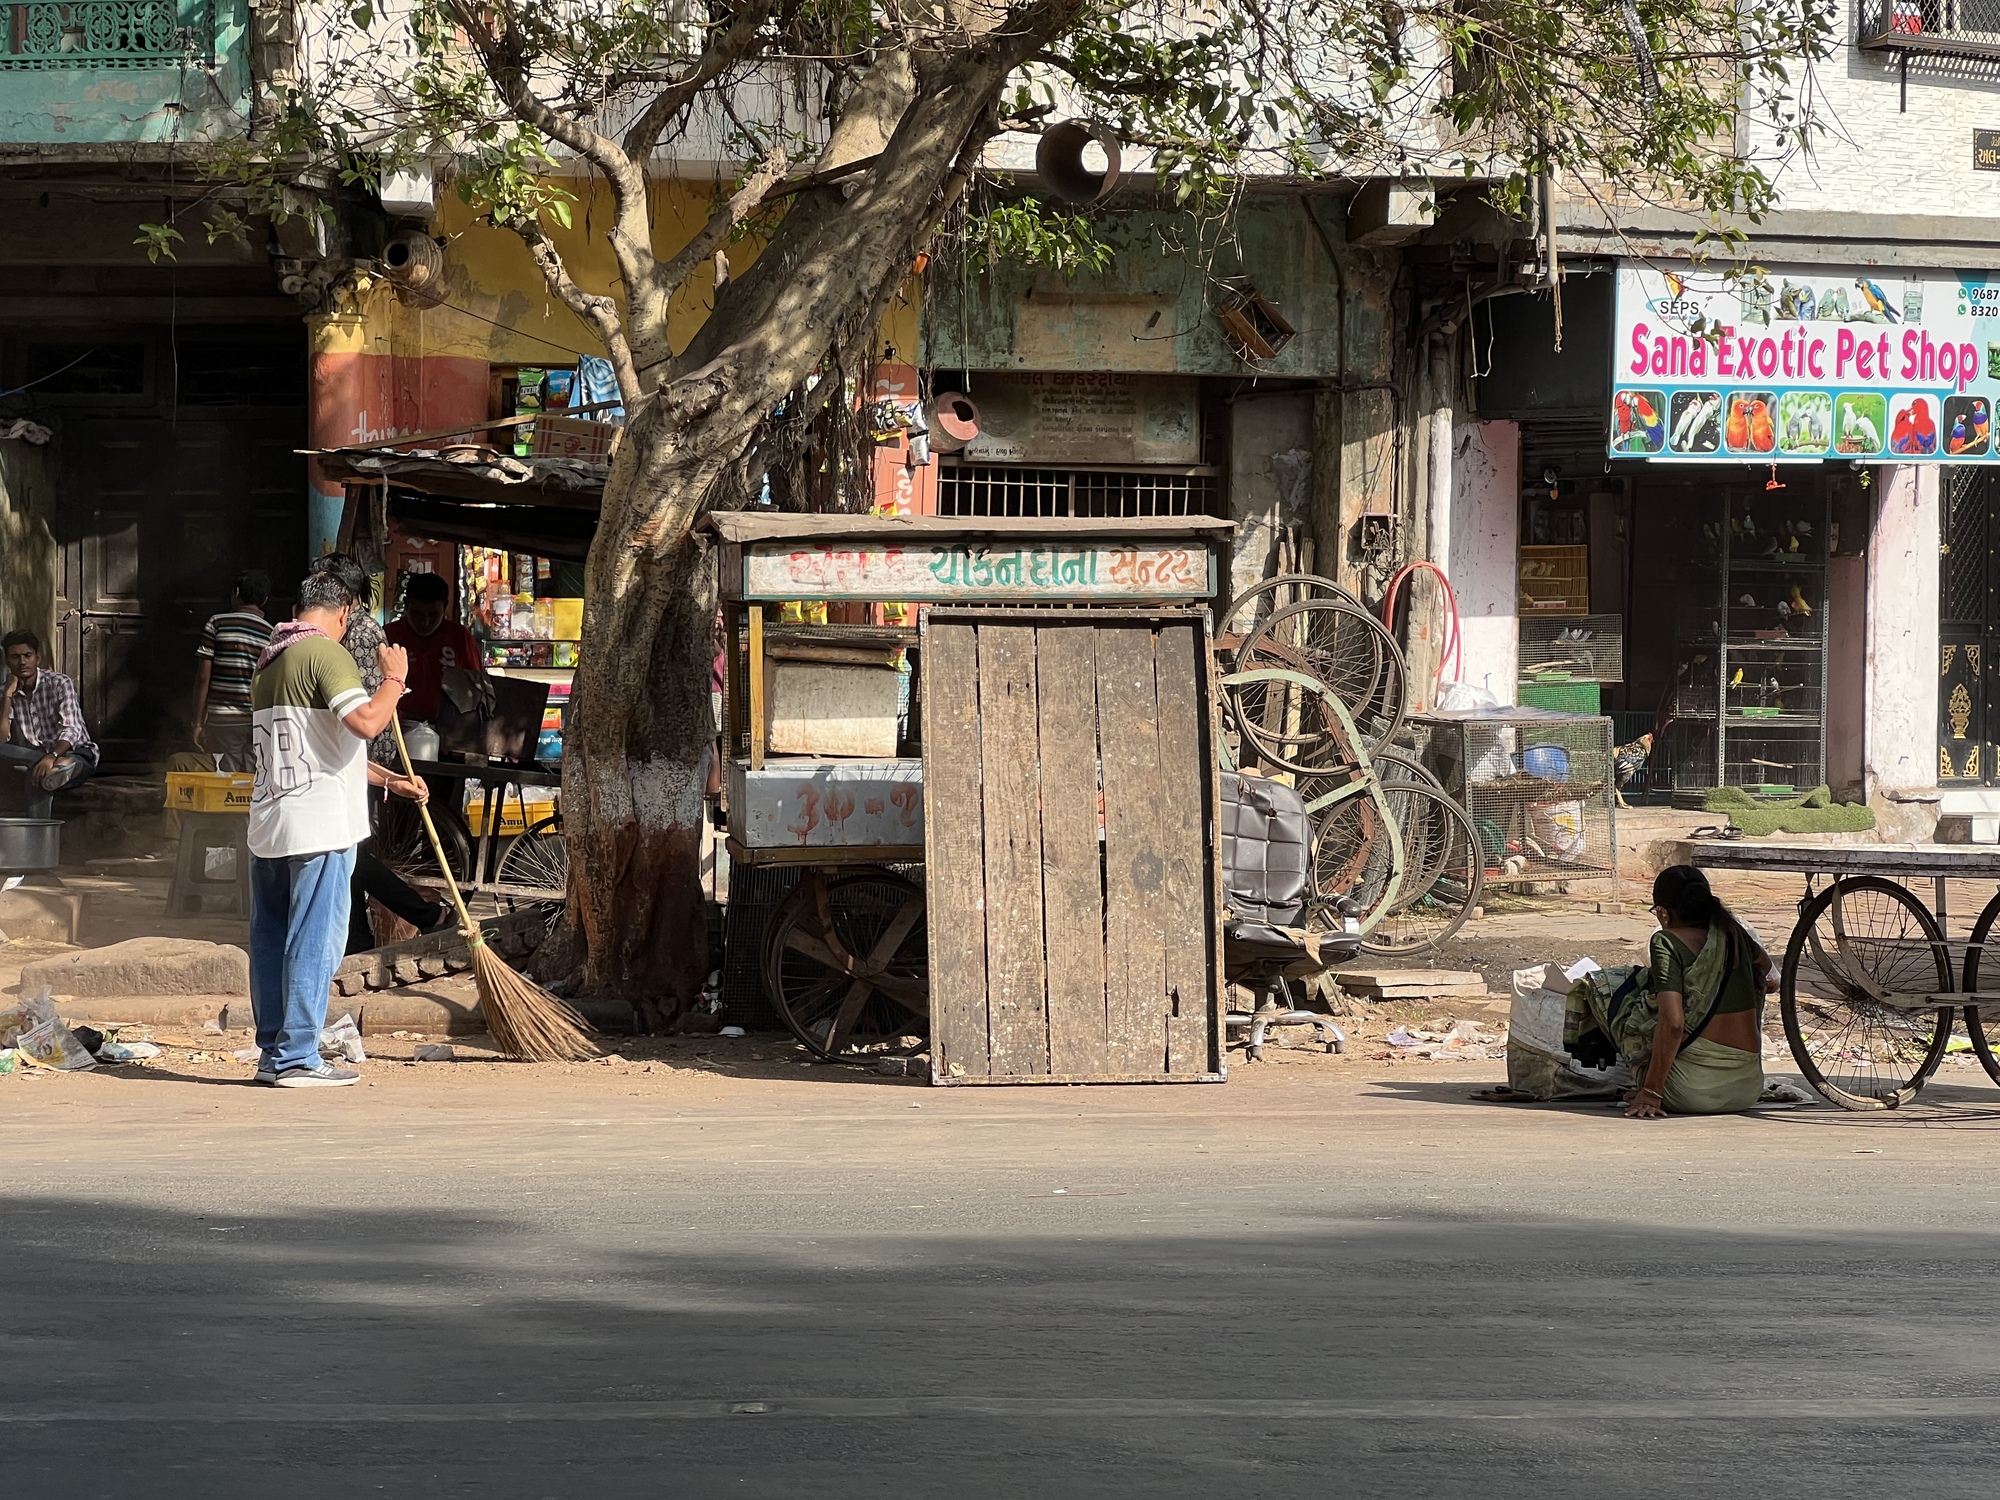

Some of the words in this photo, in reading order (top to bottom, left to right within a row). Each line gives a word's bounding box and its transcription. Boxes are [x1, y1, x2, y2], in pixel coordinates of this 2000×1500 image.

[1972, 288, 2000, 300] 9687
[1660, 301, 1699, 315] SEPS
[1970, 305, 1999, 317] 8320
[1630, 322, 1707, 377] Sana
[1717, 325, 1826, 380] Exotic
[1835, 328, 1891, 381] Pet
[1900, 328, 1980, 393] Shop
